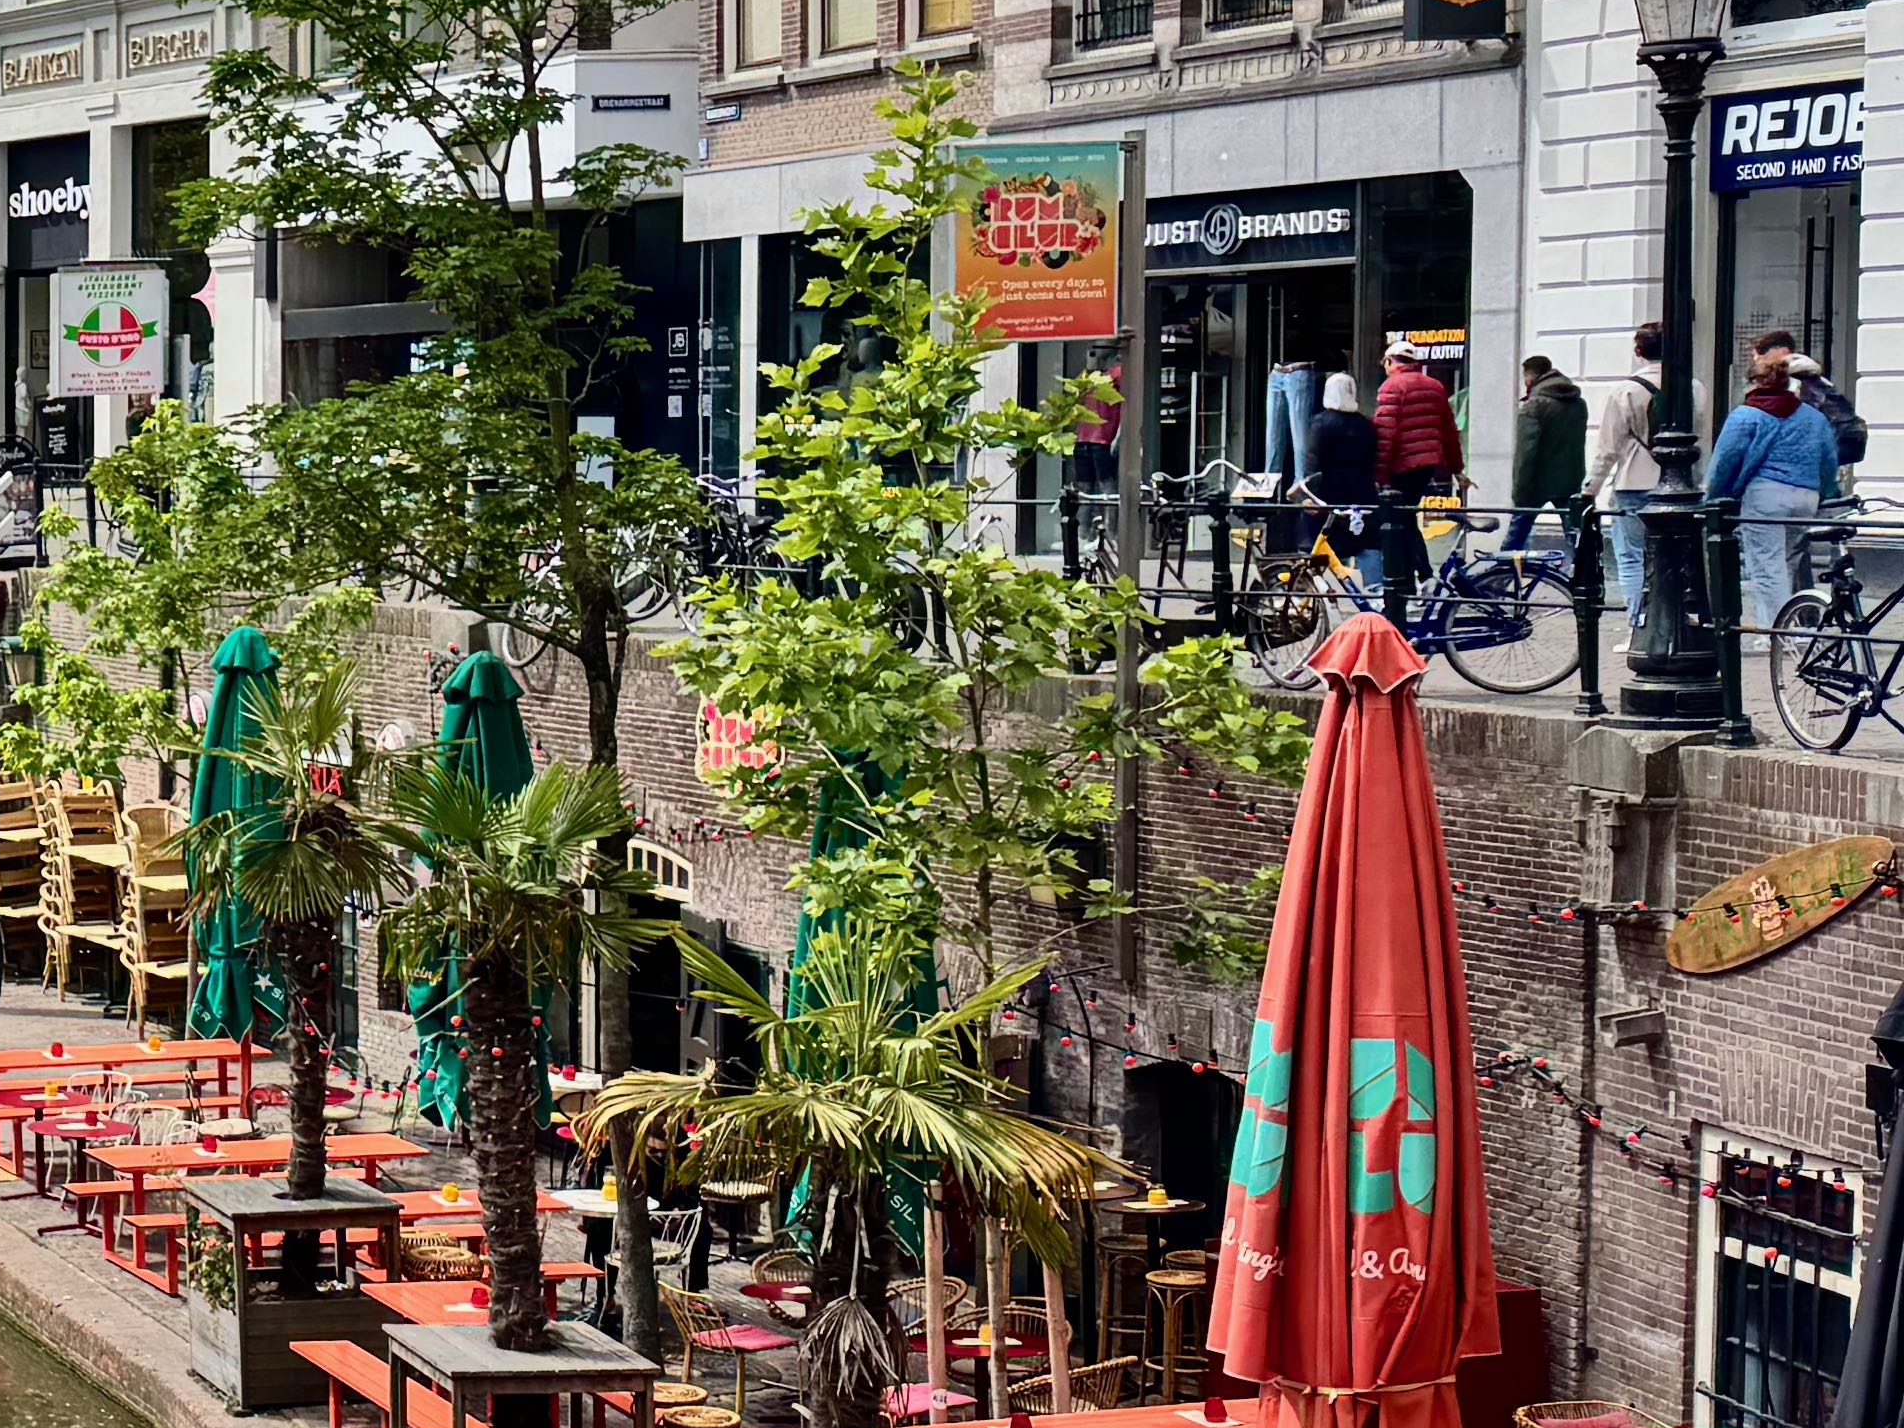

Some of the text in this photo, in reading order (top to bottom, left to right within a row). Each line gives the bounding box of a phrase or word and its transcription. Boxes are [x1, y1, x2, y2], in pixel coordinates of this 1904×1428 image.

[1736, 161, 1785, 181] SECOND
[1792, 157, 1826, 176] HAND
[9, 176, 92, 220] shoeby
[991, 194, 1063, 222] RUM
[989, 222, 1081, 253] CLUB
[1144, 220, 1200, 246] JUST
[1238, 208, 1346, 240] BRANDS
[1002, 279, 1029, 290] Open
[1031, 279, 1064, 290] every
